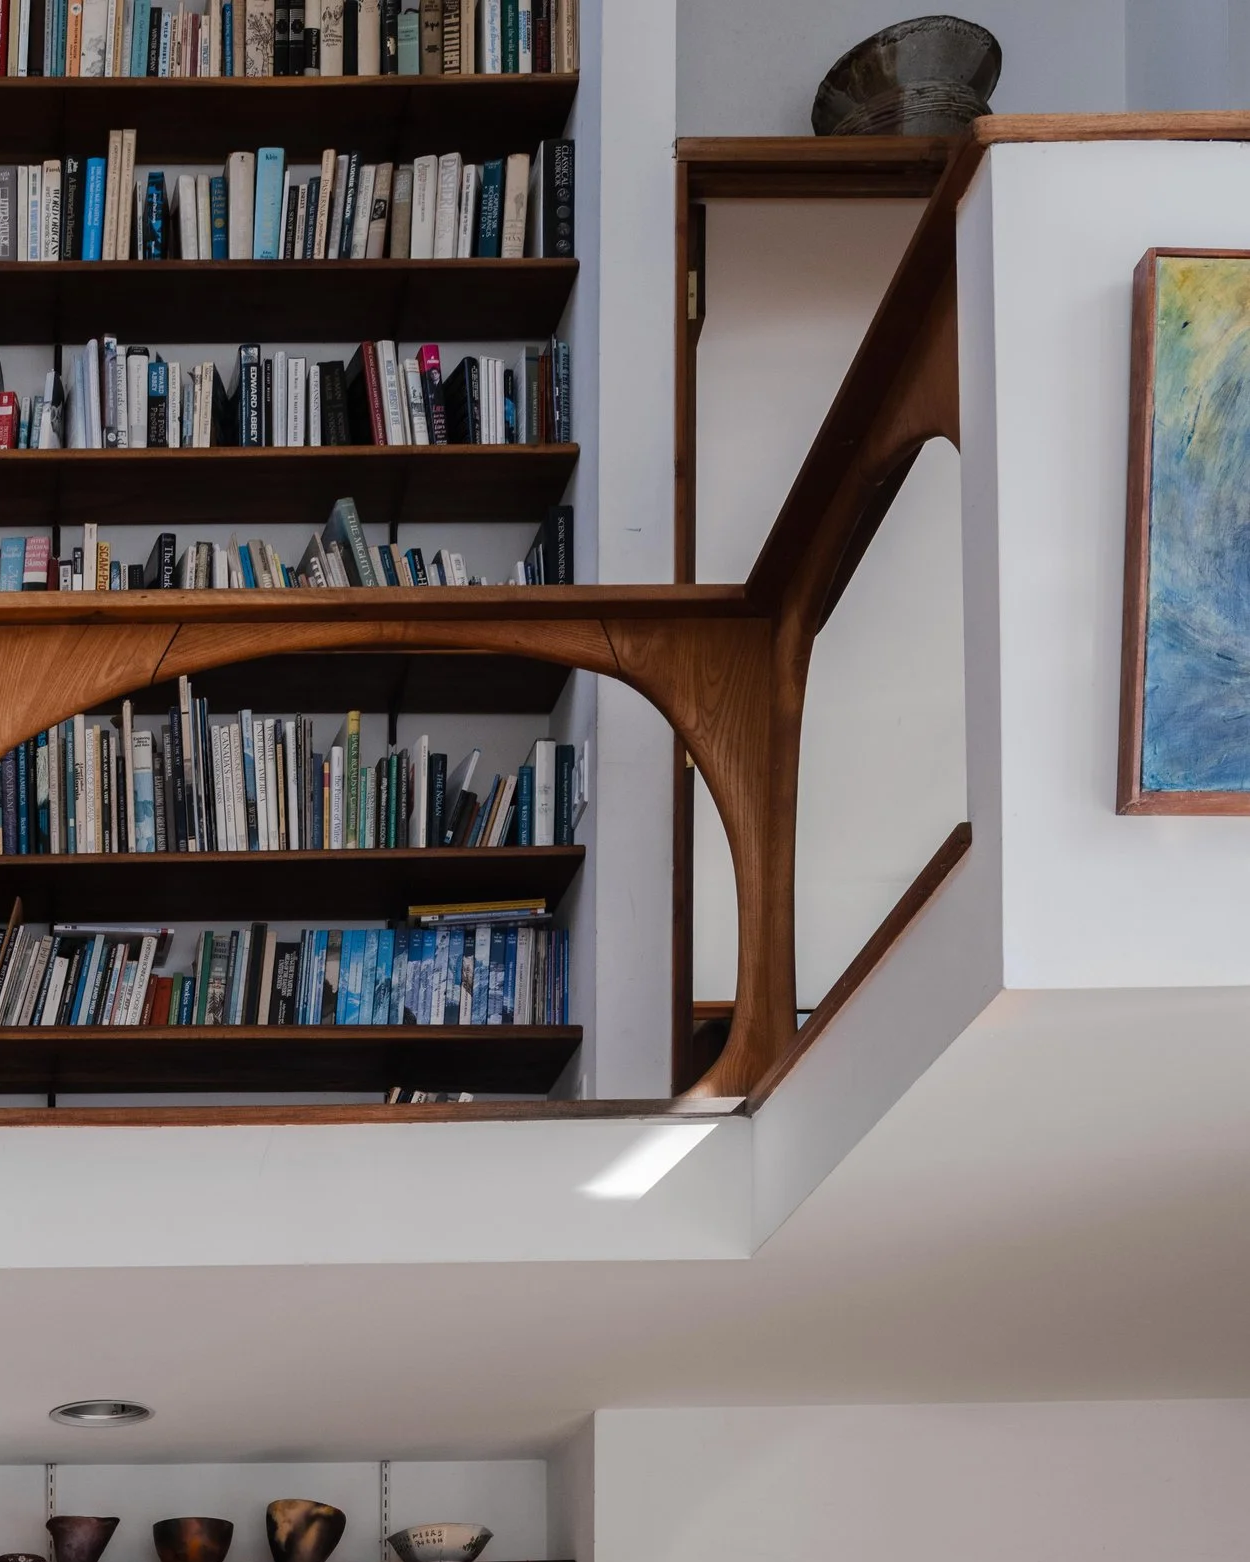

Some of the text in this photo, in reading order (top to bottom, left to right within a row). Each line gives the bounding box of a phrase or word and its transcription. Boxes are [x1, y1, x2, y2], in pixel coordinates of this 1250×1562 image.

[561, 145, 569, 185] CLASSICAL
[67, 185, 76, 220] Browser's
[345, 155, 357, 218] VLADIMIR NABOKOV
[51, 189, 60, 255] WORD ORIGINS
[65, 222, 73, 258] Dictionary
[347, 512, 371, 576] THE MIGHTY
[164, 545, 173, 587] The Dark
[334, 811, 340, 819] of
[183, 981, 191, 1005] Smokies
